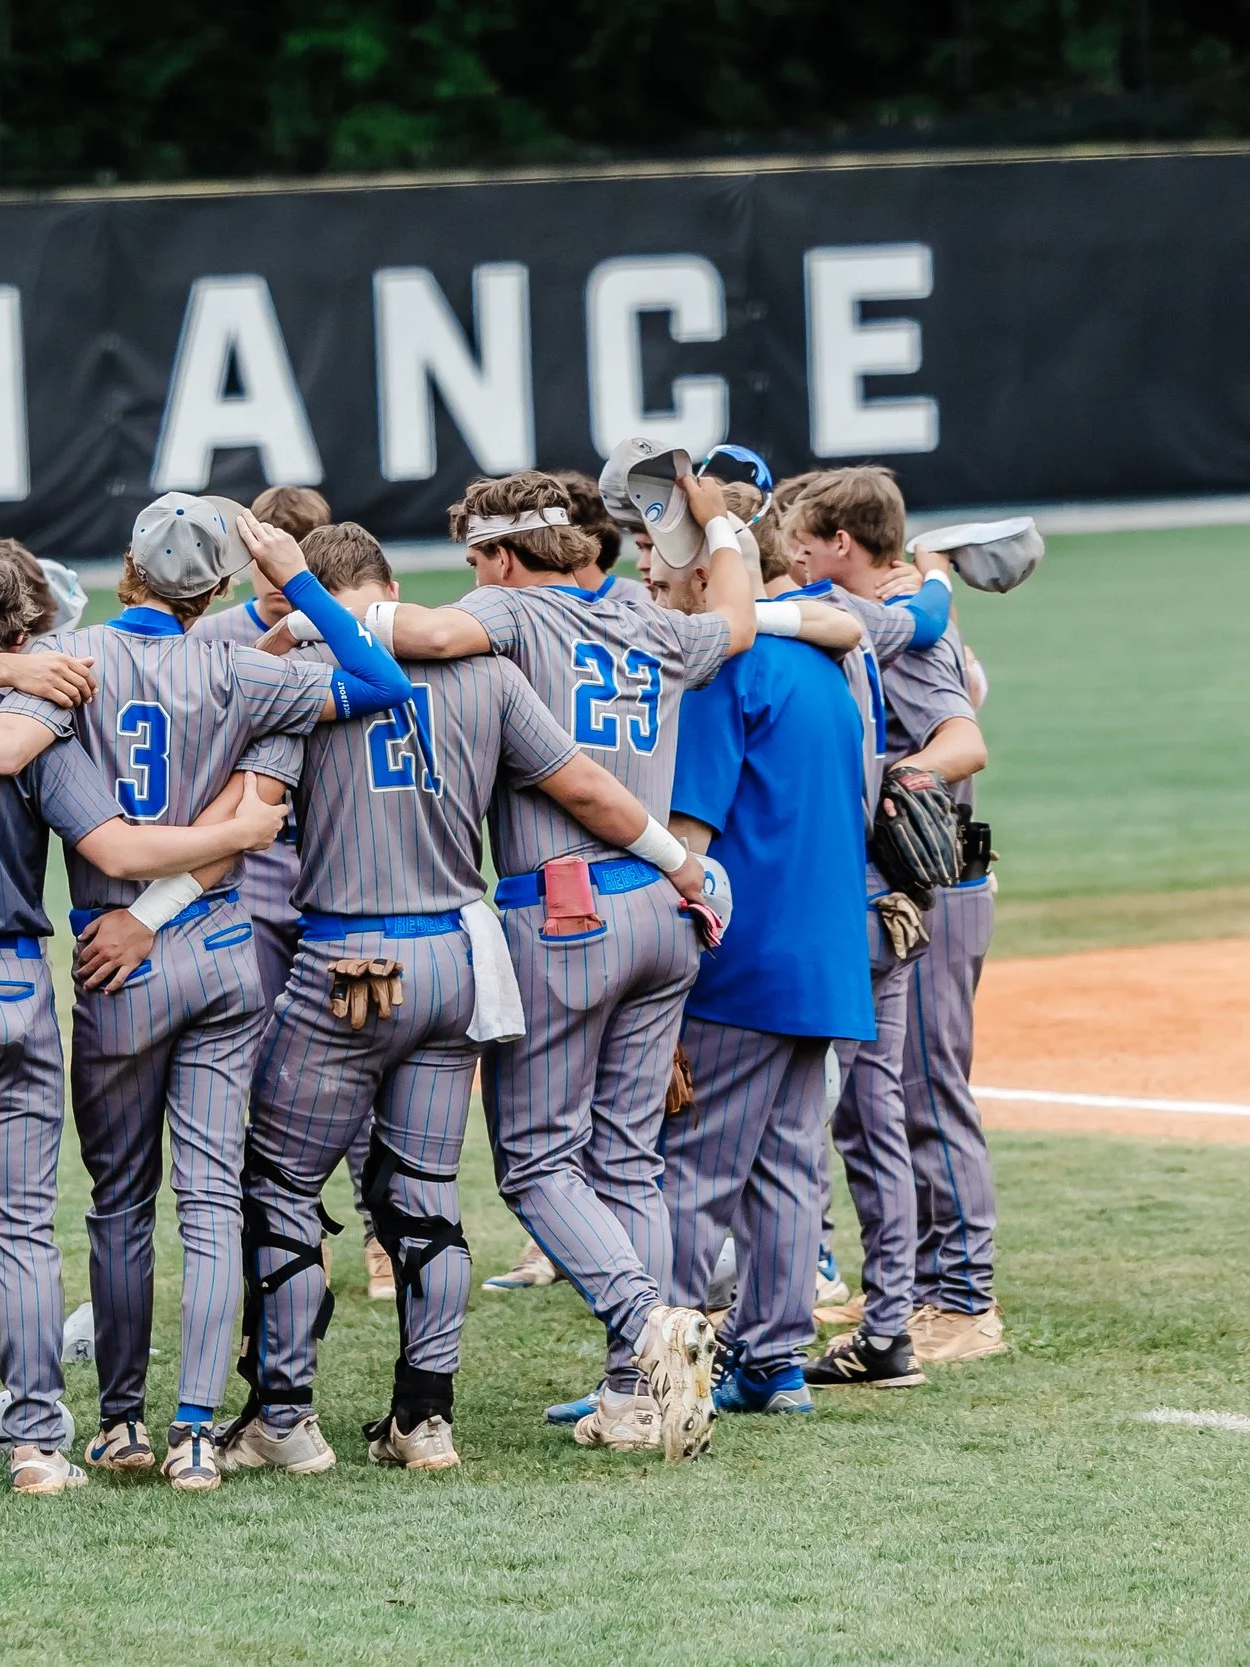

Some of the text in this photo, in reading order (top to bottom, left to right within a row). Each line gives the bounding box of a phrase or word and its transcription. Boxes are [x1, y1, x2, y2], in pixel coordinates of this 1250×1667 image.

[365, 682, 443, 799] 21
[571, 638, 662, 756] 23
[115, 700, 171, 820] 3
[394, 914, 453, 934] REBELS
[601, 863, 653, 890] REBELS
